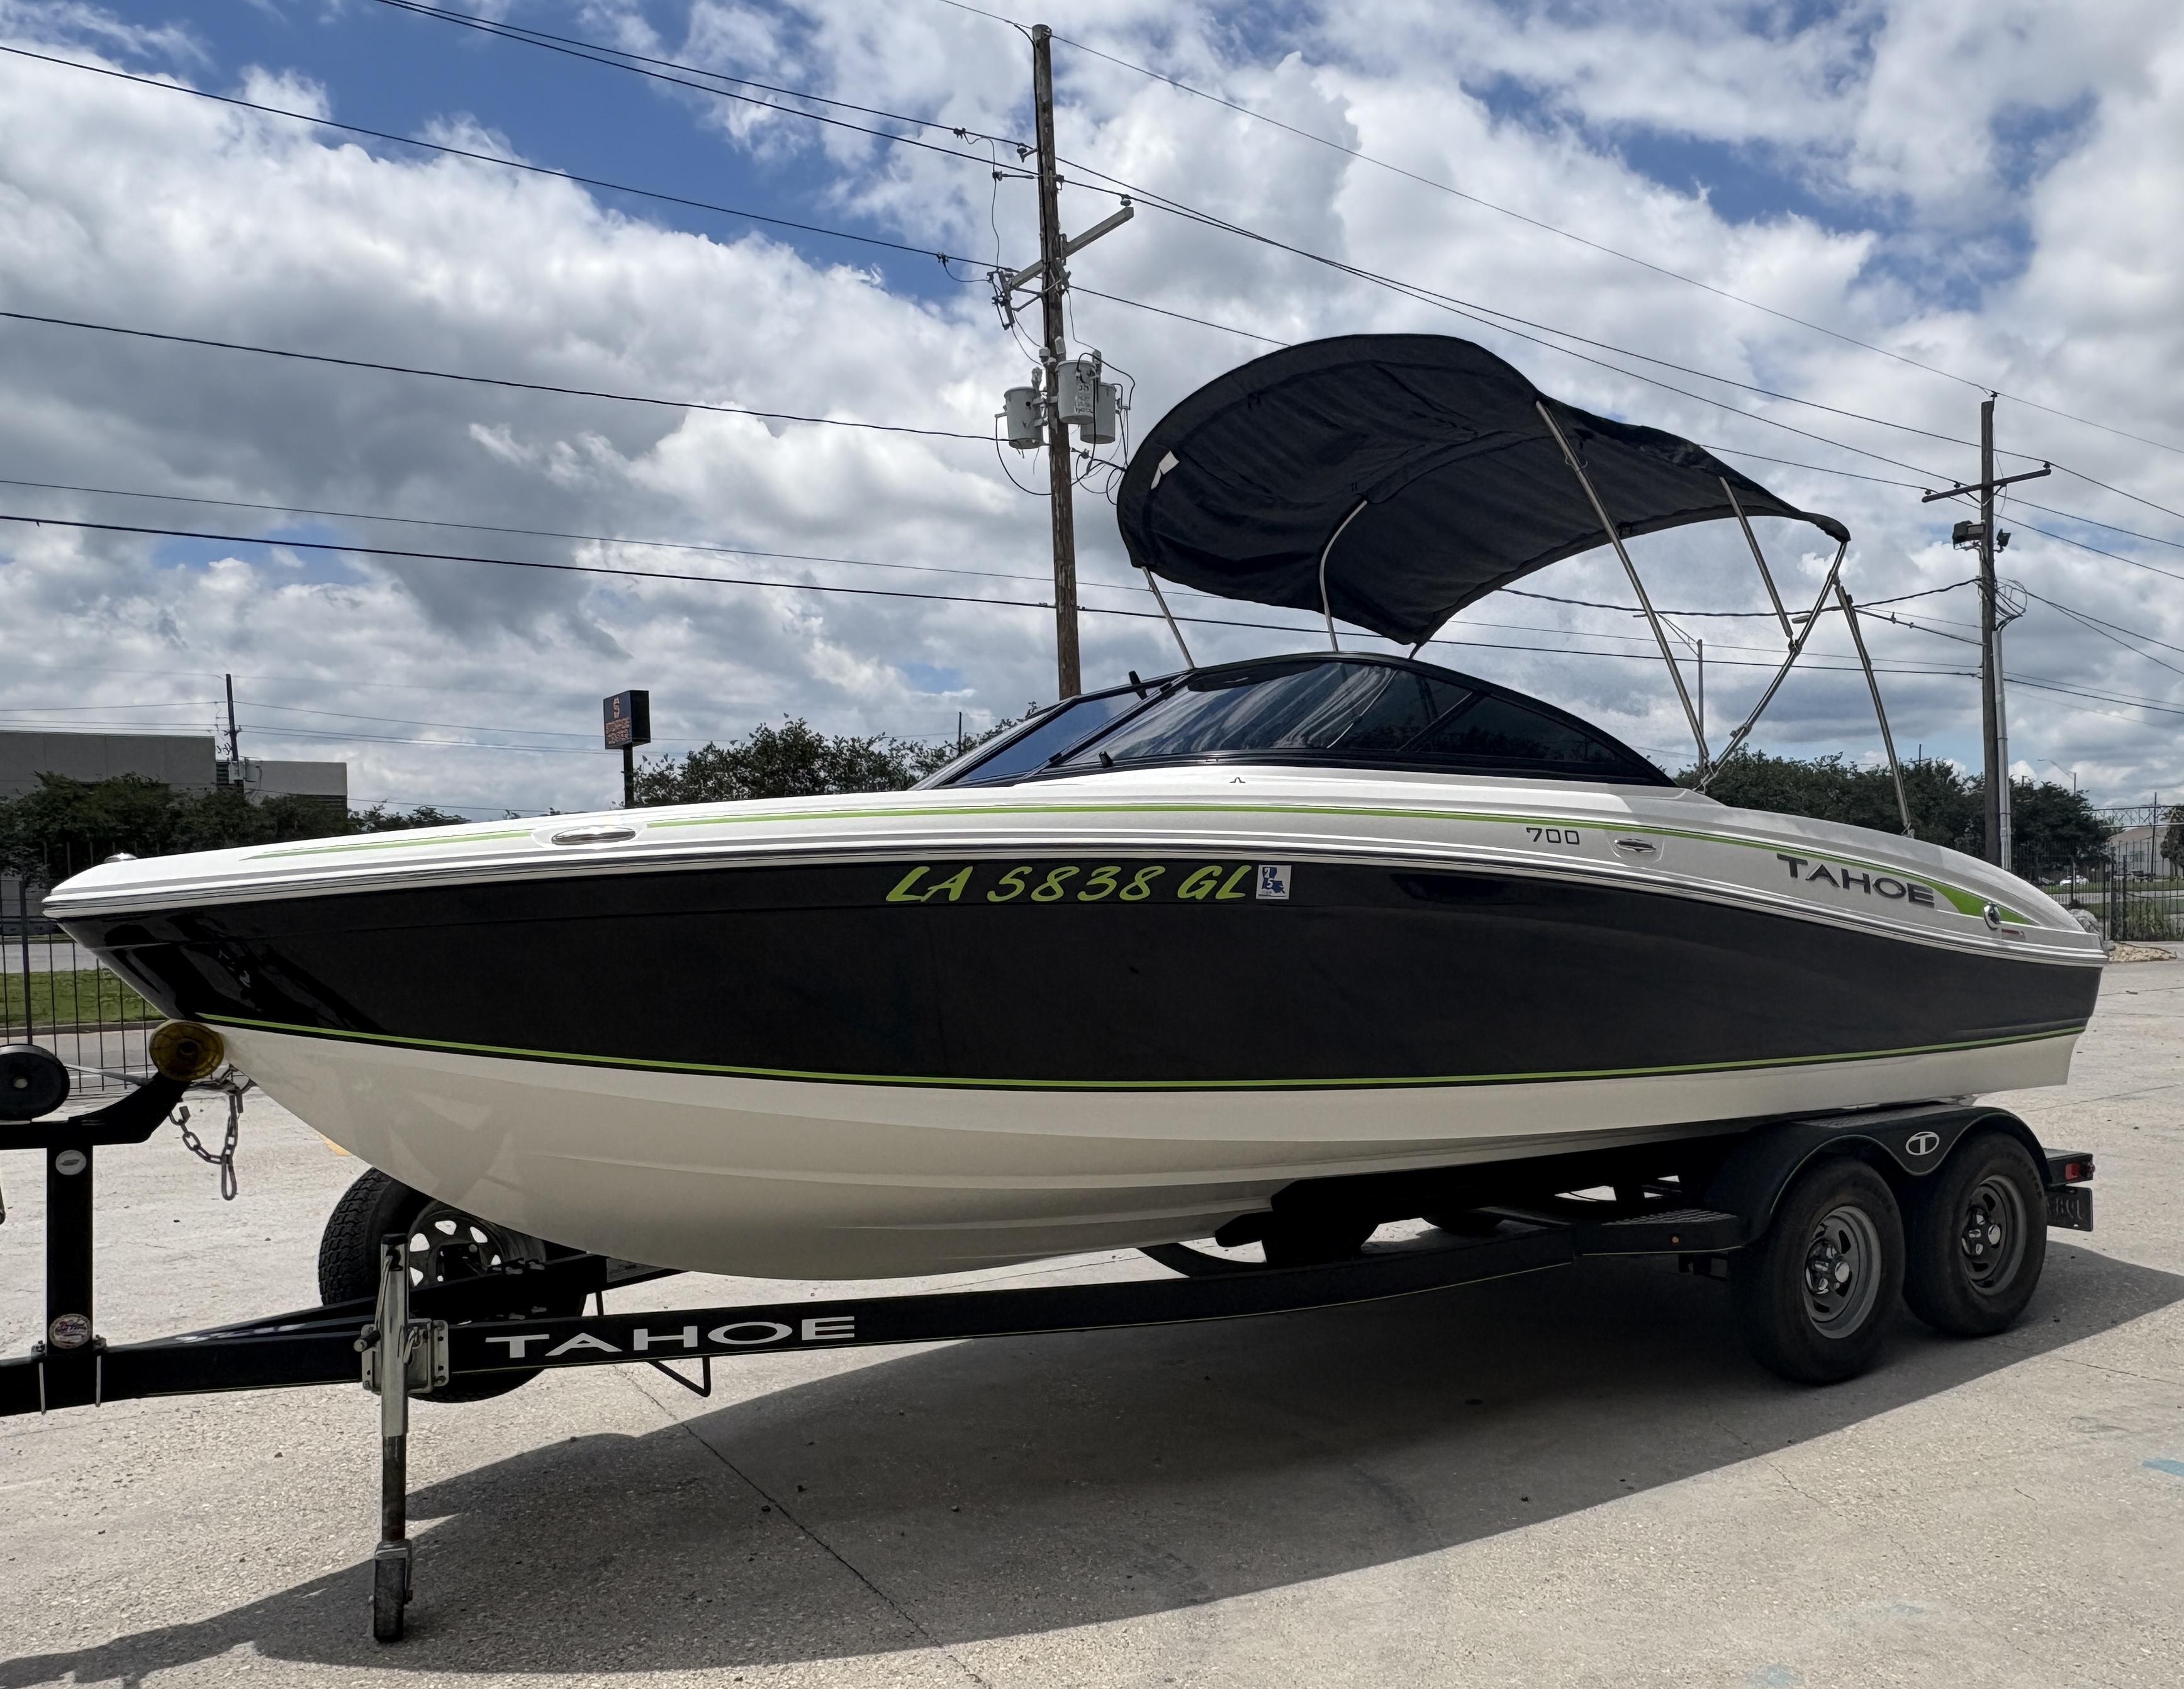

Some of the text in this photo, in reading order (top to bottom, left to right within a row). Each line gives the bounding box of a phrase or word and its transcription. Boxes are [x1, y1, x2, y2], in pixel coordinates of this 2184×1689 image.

[1526, 827, 1580, 845] 700
[885, 865, 1252, 902] LA 5838 GL
[1776, 852, 1935, 909] TAHOE
[485, 1316, 855, 1358] TAHOE
